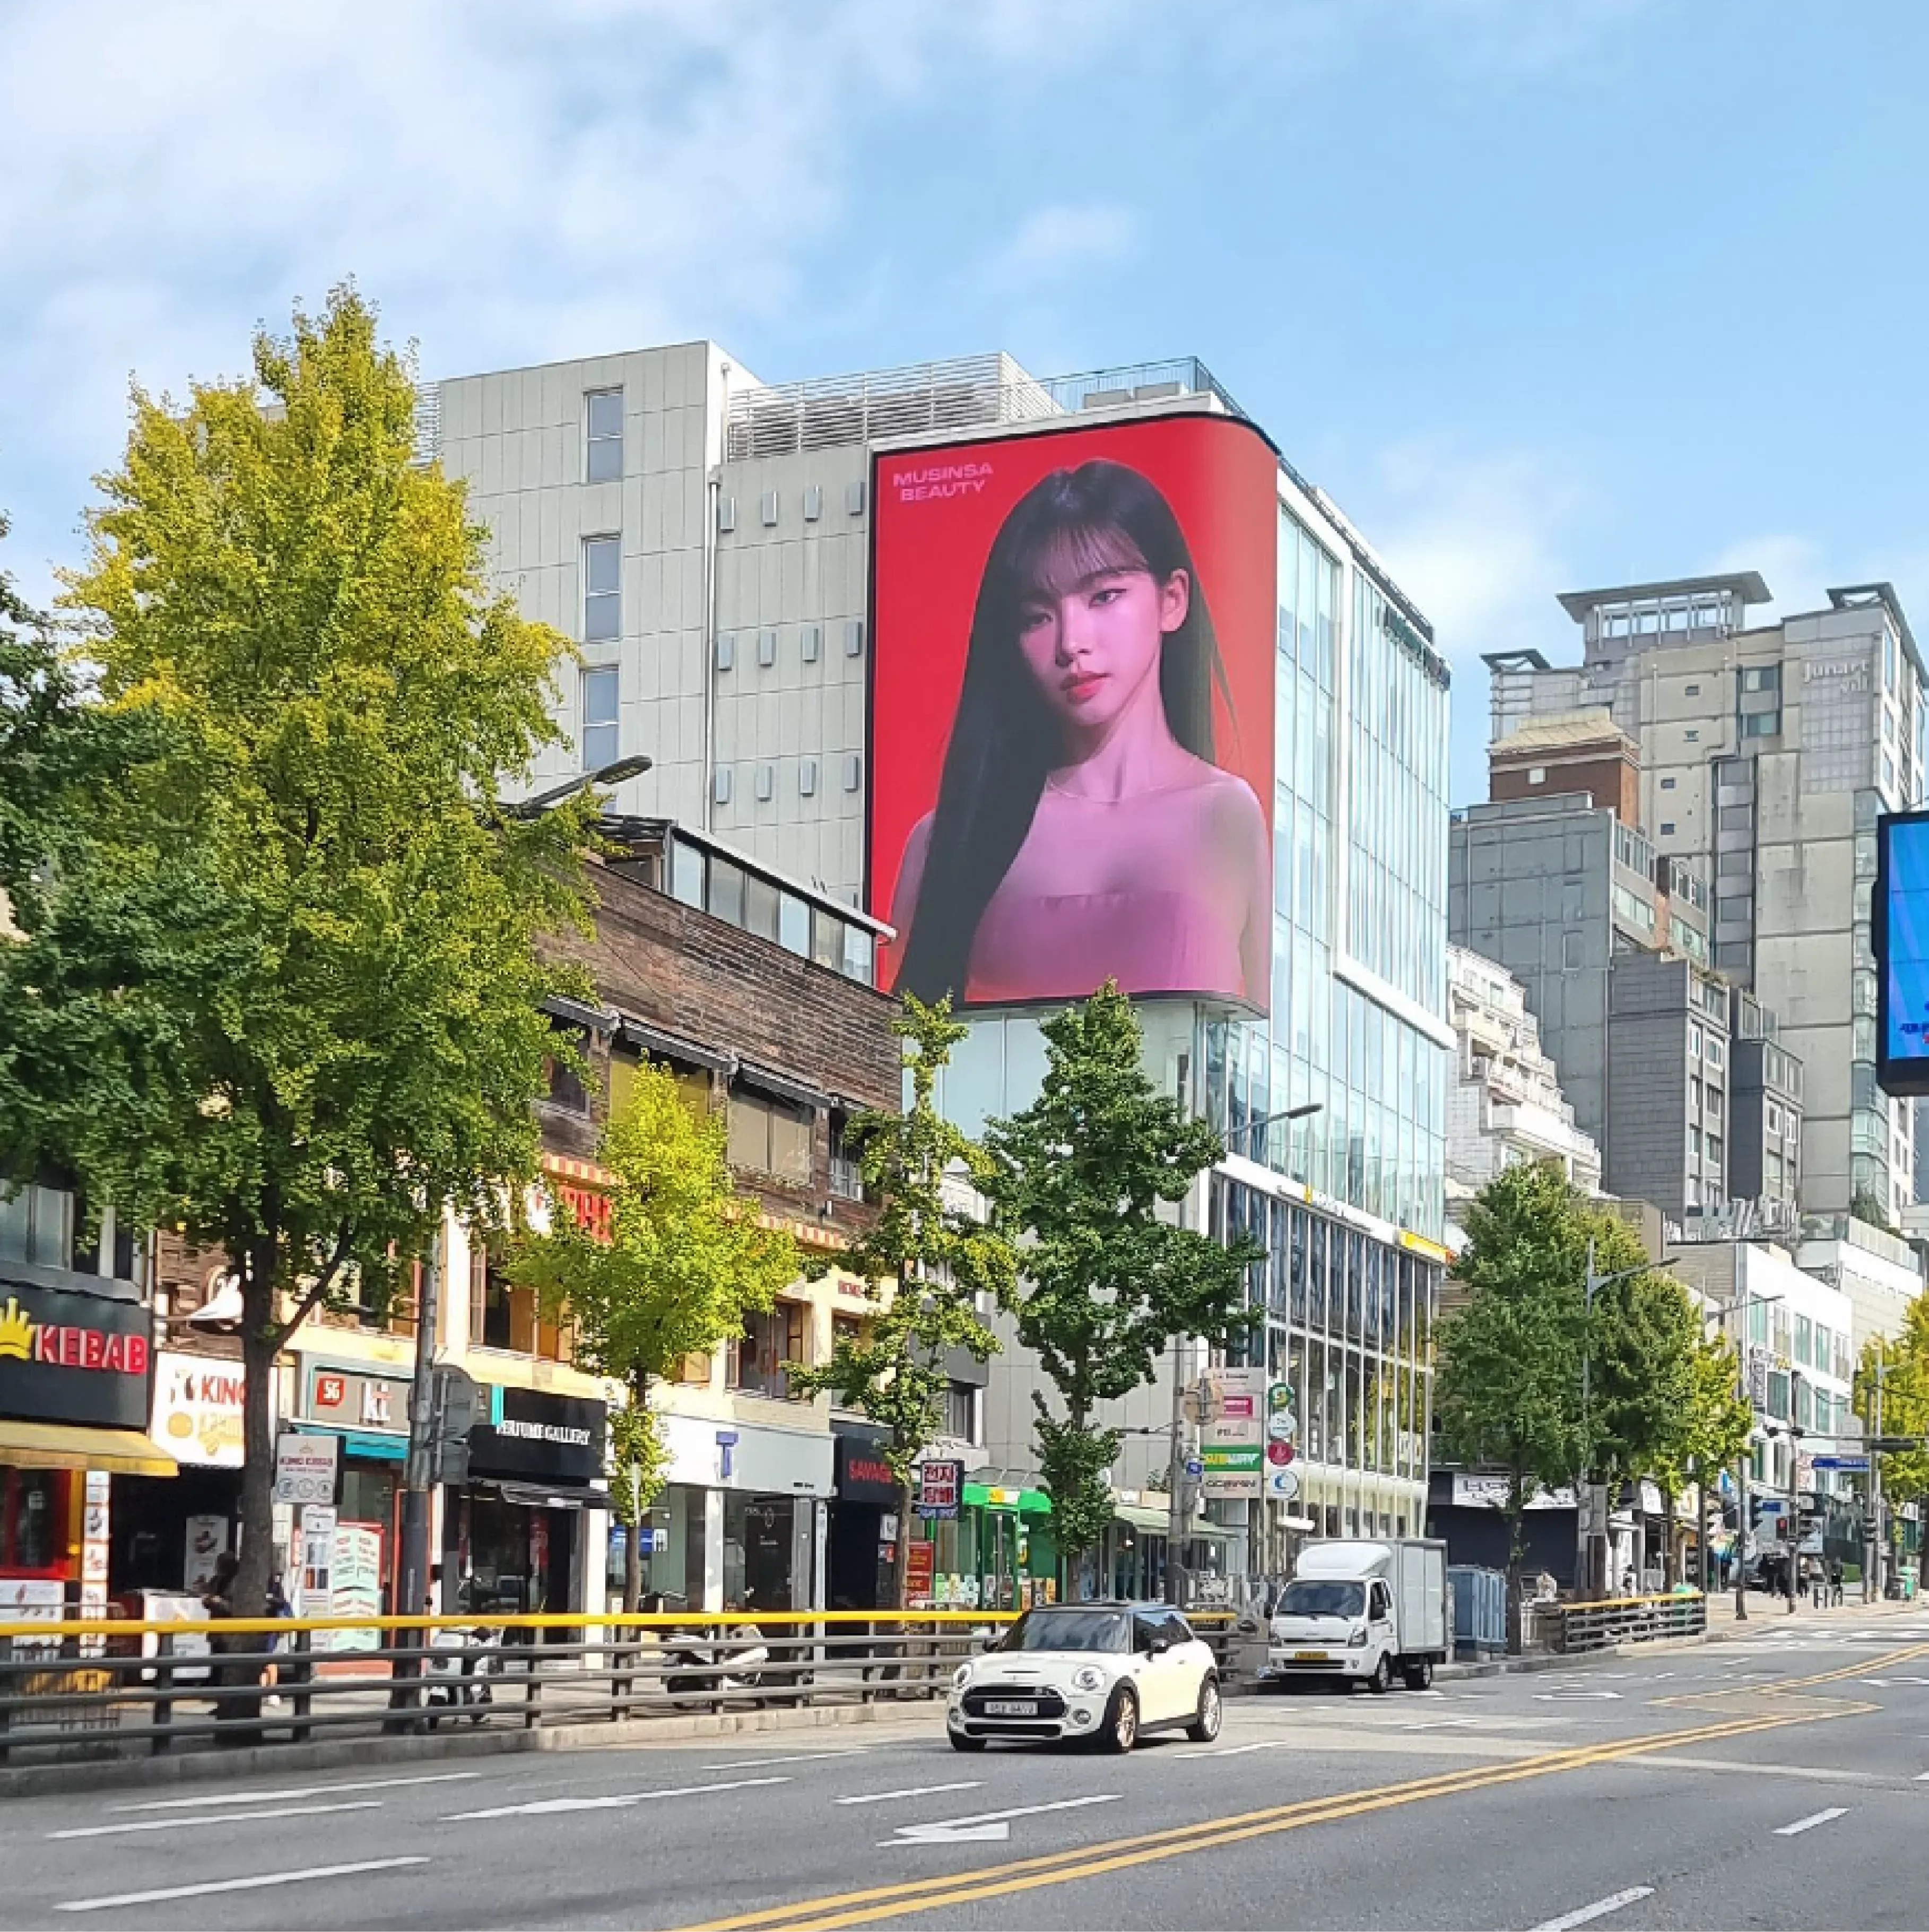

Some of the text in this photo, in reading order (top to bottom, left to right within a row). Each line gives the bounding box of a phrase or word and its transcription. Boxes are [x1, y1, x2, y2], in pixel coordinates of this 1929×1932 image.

[893, 462, 994, 487] MUSINSA
[900, 480, 985, 501] BEAUTY
[35, 1324, 147, 1375] KEBAB
[1203, 1452, 1260, 1468] SUBWAY
